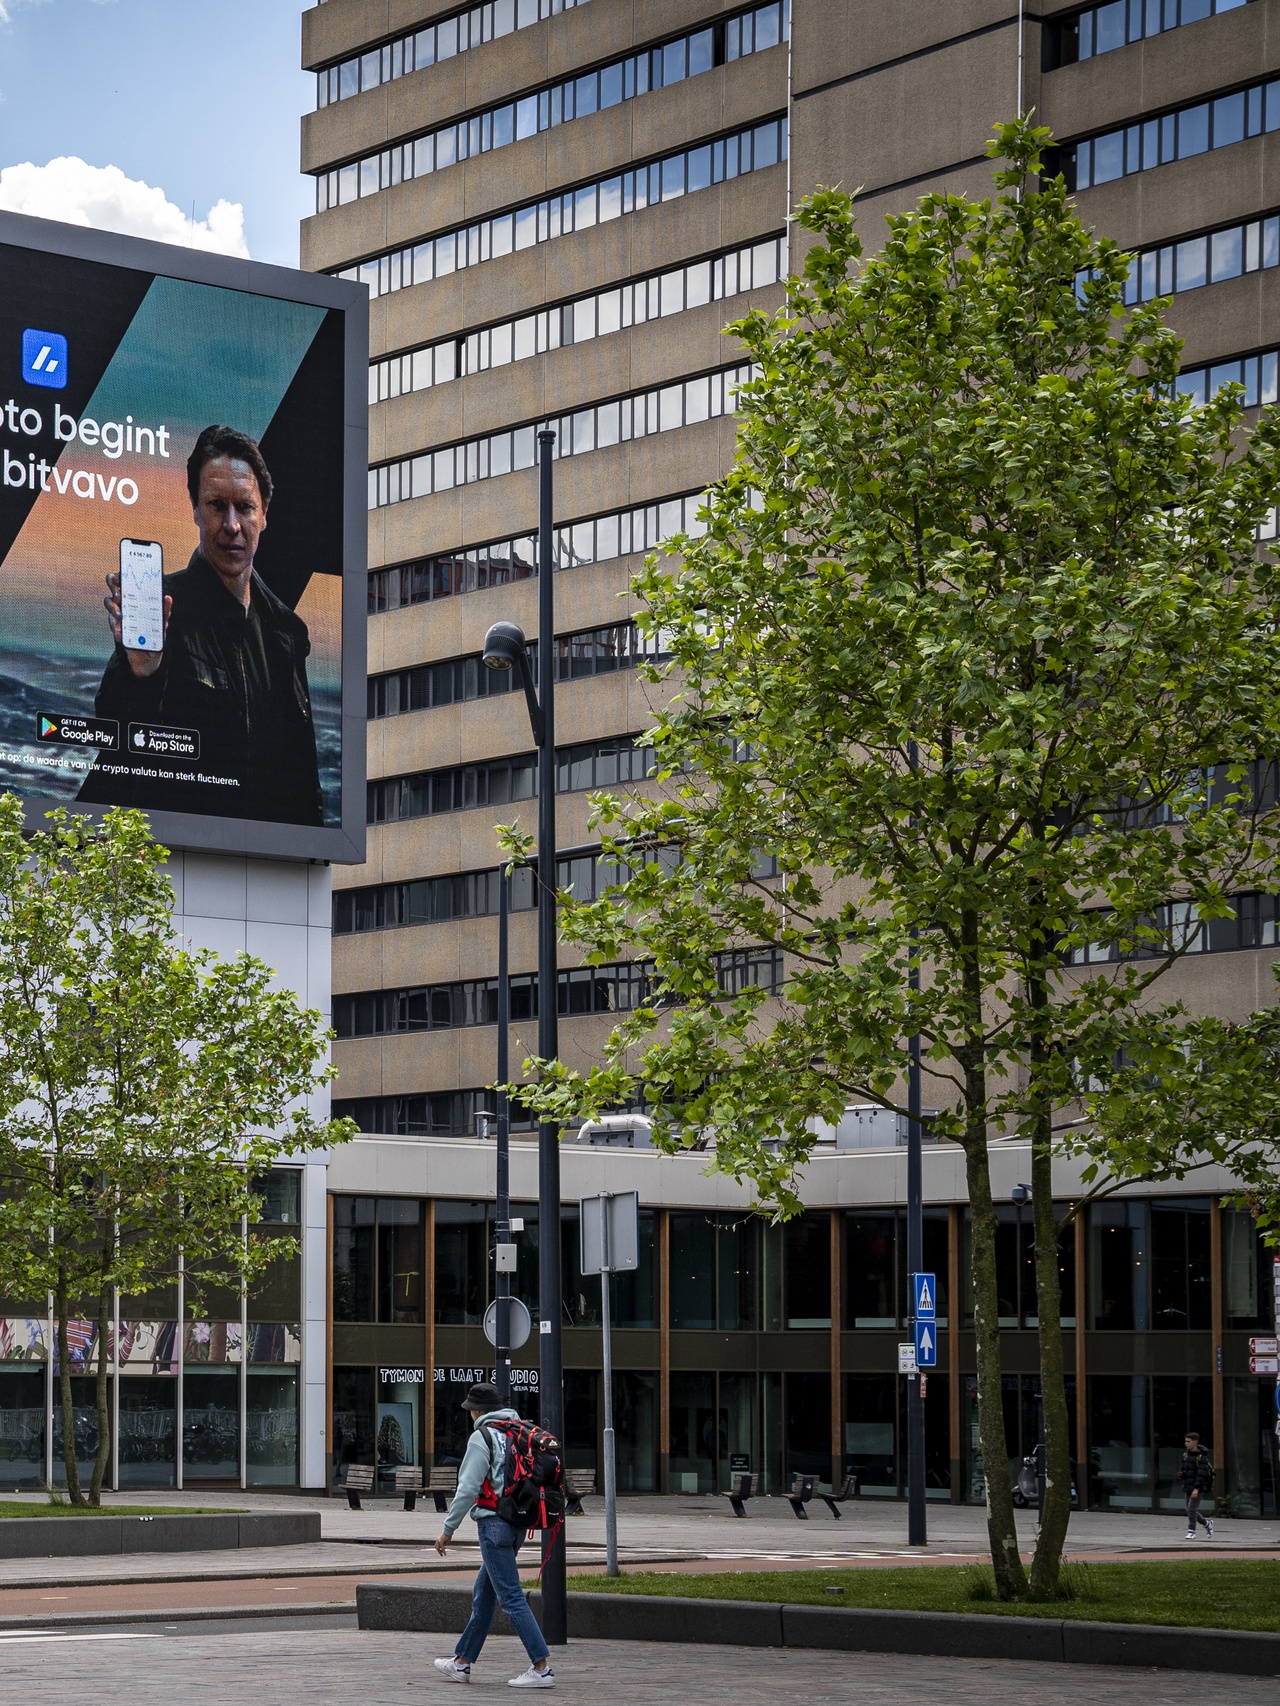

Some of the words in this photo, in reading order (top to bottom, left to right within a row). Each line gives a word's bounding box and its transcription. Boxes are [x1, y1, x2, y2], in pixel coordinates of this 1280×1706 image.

[54, 404, 171, 460] begint
[4, 448, 139, 506] bitvavo
[61, 718, 72, 726] GET
[61, 727, 95, 742] Google
[95, 730, 114, 746] Play
[149, 730, 174, 739] Download
[148, 738, 168, 752] App
[170, 740, 194, 753] Store
[8, 752, 22, 764] op:
[23, 754, 34, 764] de
[36, 755, 68, 768] waarde
[70, 760, 86, 769] van
[88, 762, 100, 771] uw
[102, 764, 130, 775] crypto
[131, 766, 157, 778] valuta
[158, 769, 174, 779] kan
[176, 772, 196, 782] sterk
[197, 773, 241, 786] fluctueren.
[380, 1368, 424, 1383] TYMON
[450, 1368, 484, 1382] LAAT
[490, 1369, 538, 1385] SUDIO
